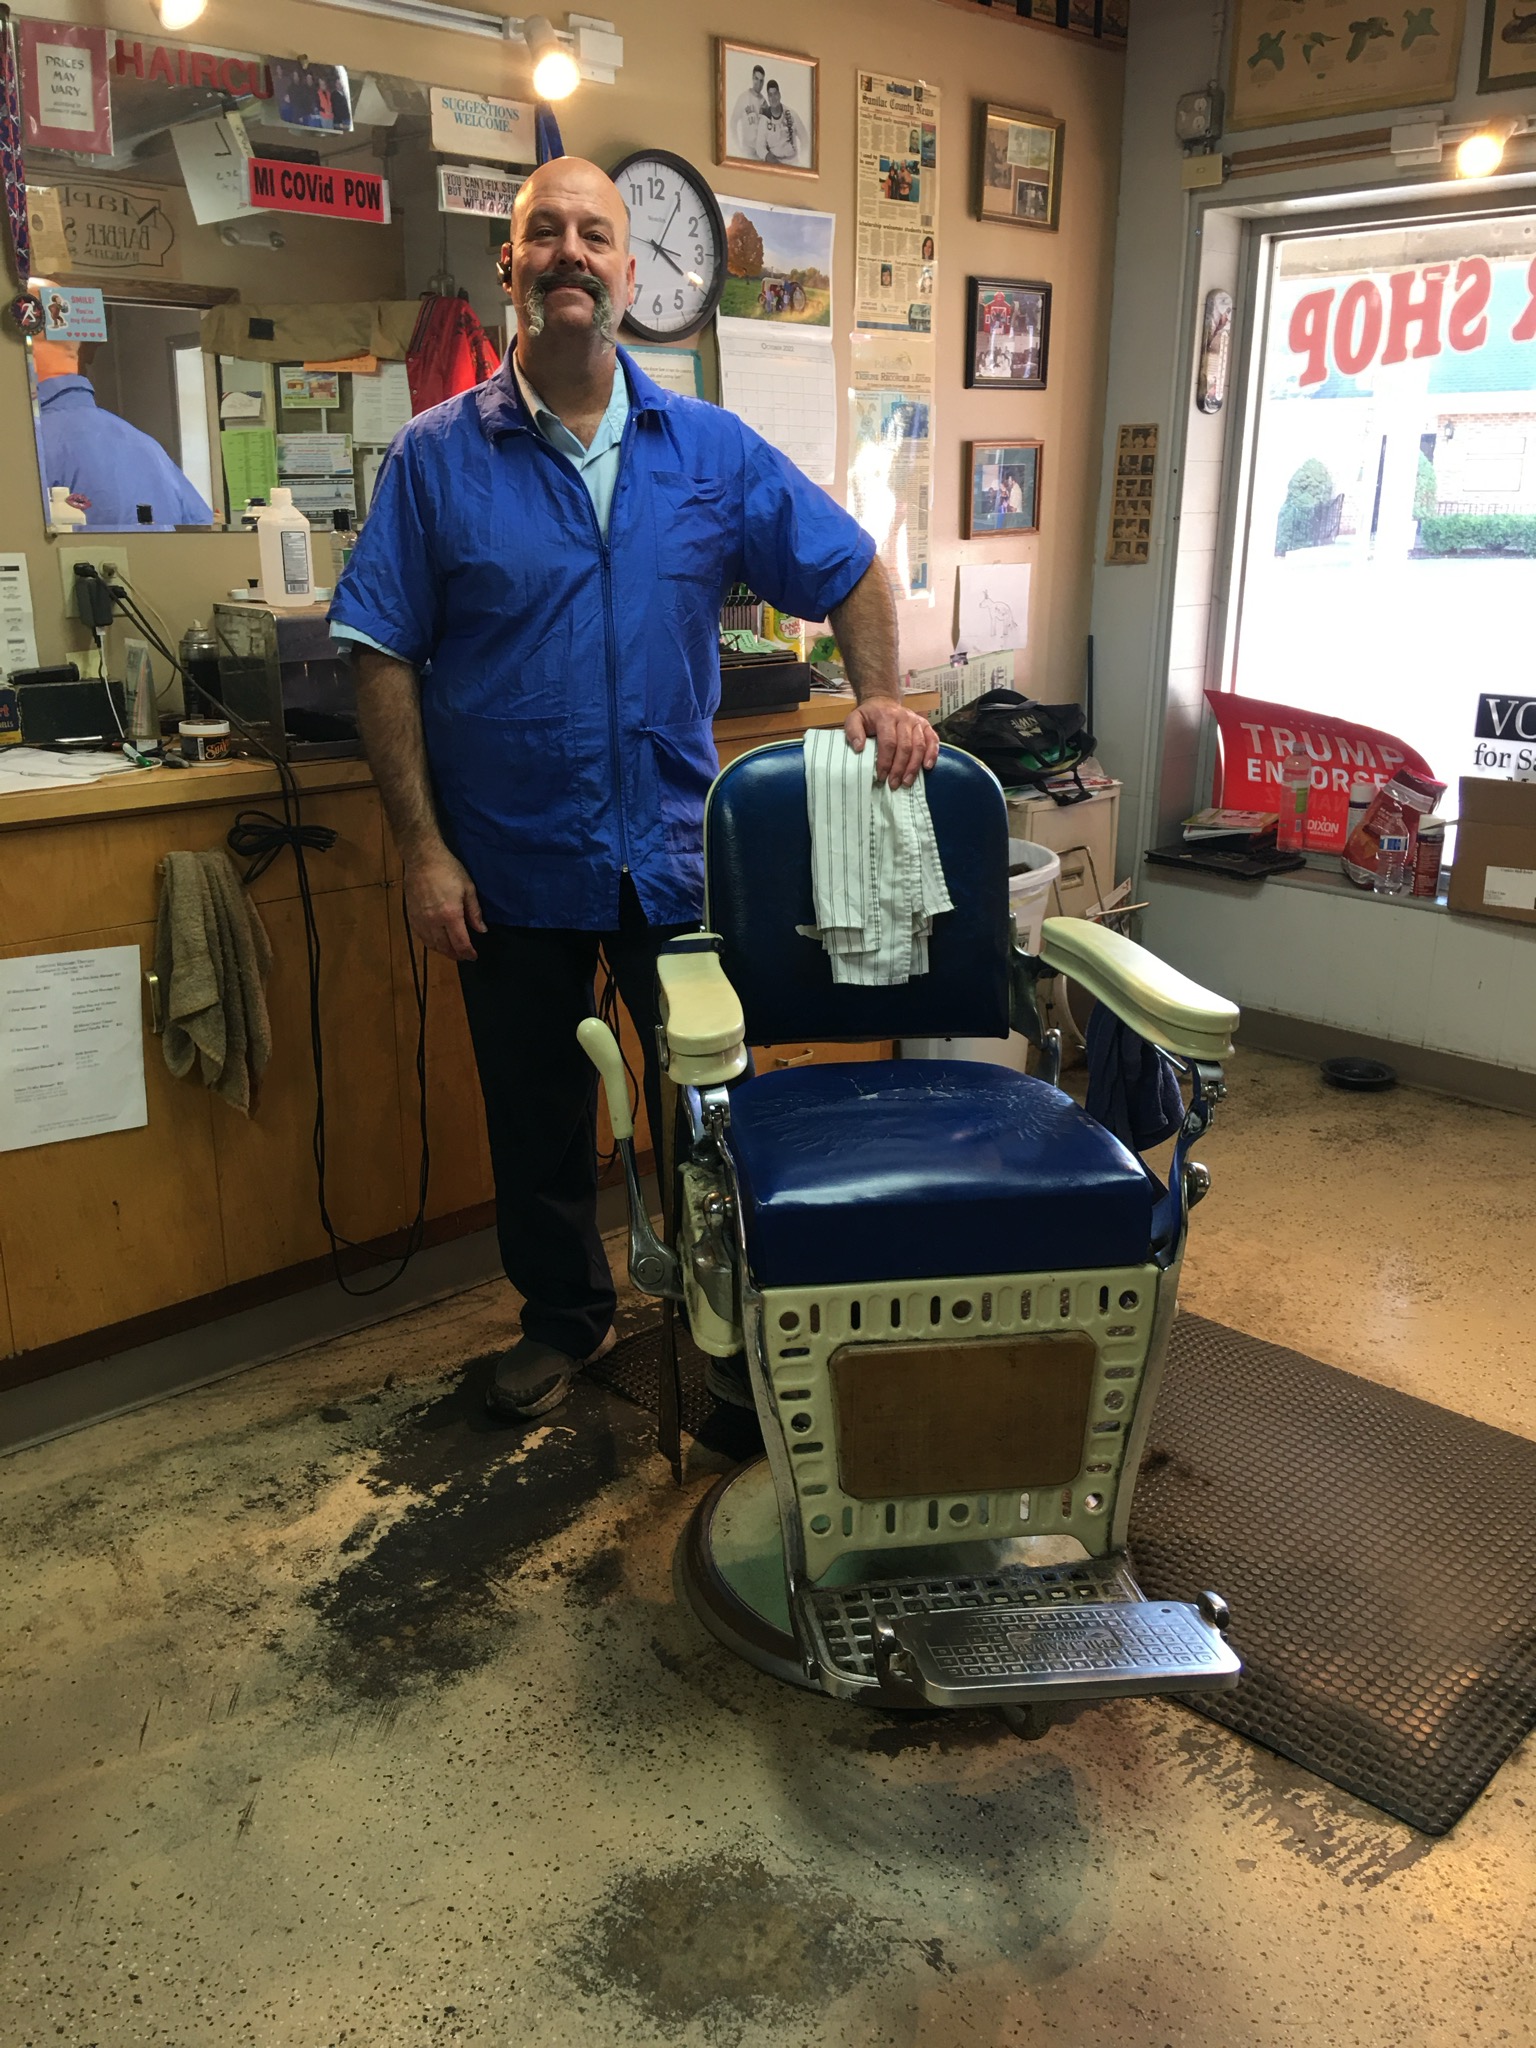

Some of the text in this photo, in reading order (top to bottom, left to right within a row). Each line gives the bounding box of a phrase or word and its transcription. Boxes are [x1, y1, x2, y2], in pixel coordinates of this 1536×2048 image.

[45, 56, 85, 70] PRICES
[53, 71, 76, 82] MAY
[50, 84, 81, 97] VARY
[441, 96, 520, 121] SUGGESTIONS
[889, 98, 915, 115] County
[916, 103, 934, 117] News
[454, 112, 513, 133] WELCOME.
[253, 166, 381, 211] MI COVid POW
[447, 186, 461, 196] BUT
[464, 187, 479, 198] YOU
[481, 190, 496, 200] CAN
[630, 184, 643, 207] 11
[648, 177, 665, 201] 12
[462, 197, 486, 210] WITH
[488, 201, 495, 212] A
[674, 192, 682, 212] 1
[688, 216, 699, 238] 2
[694, 244, 704, 266] 3
[633, 284, 643, 305] 7
[652, 294, 663, 316] 6
[673, 289, 684, 311] 5
[1240, 722, 1406, 771] TRUMP
[1473, 742, 1512, 769] for
[1307, 819, 1340, 834] DIXON
